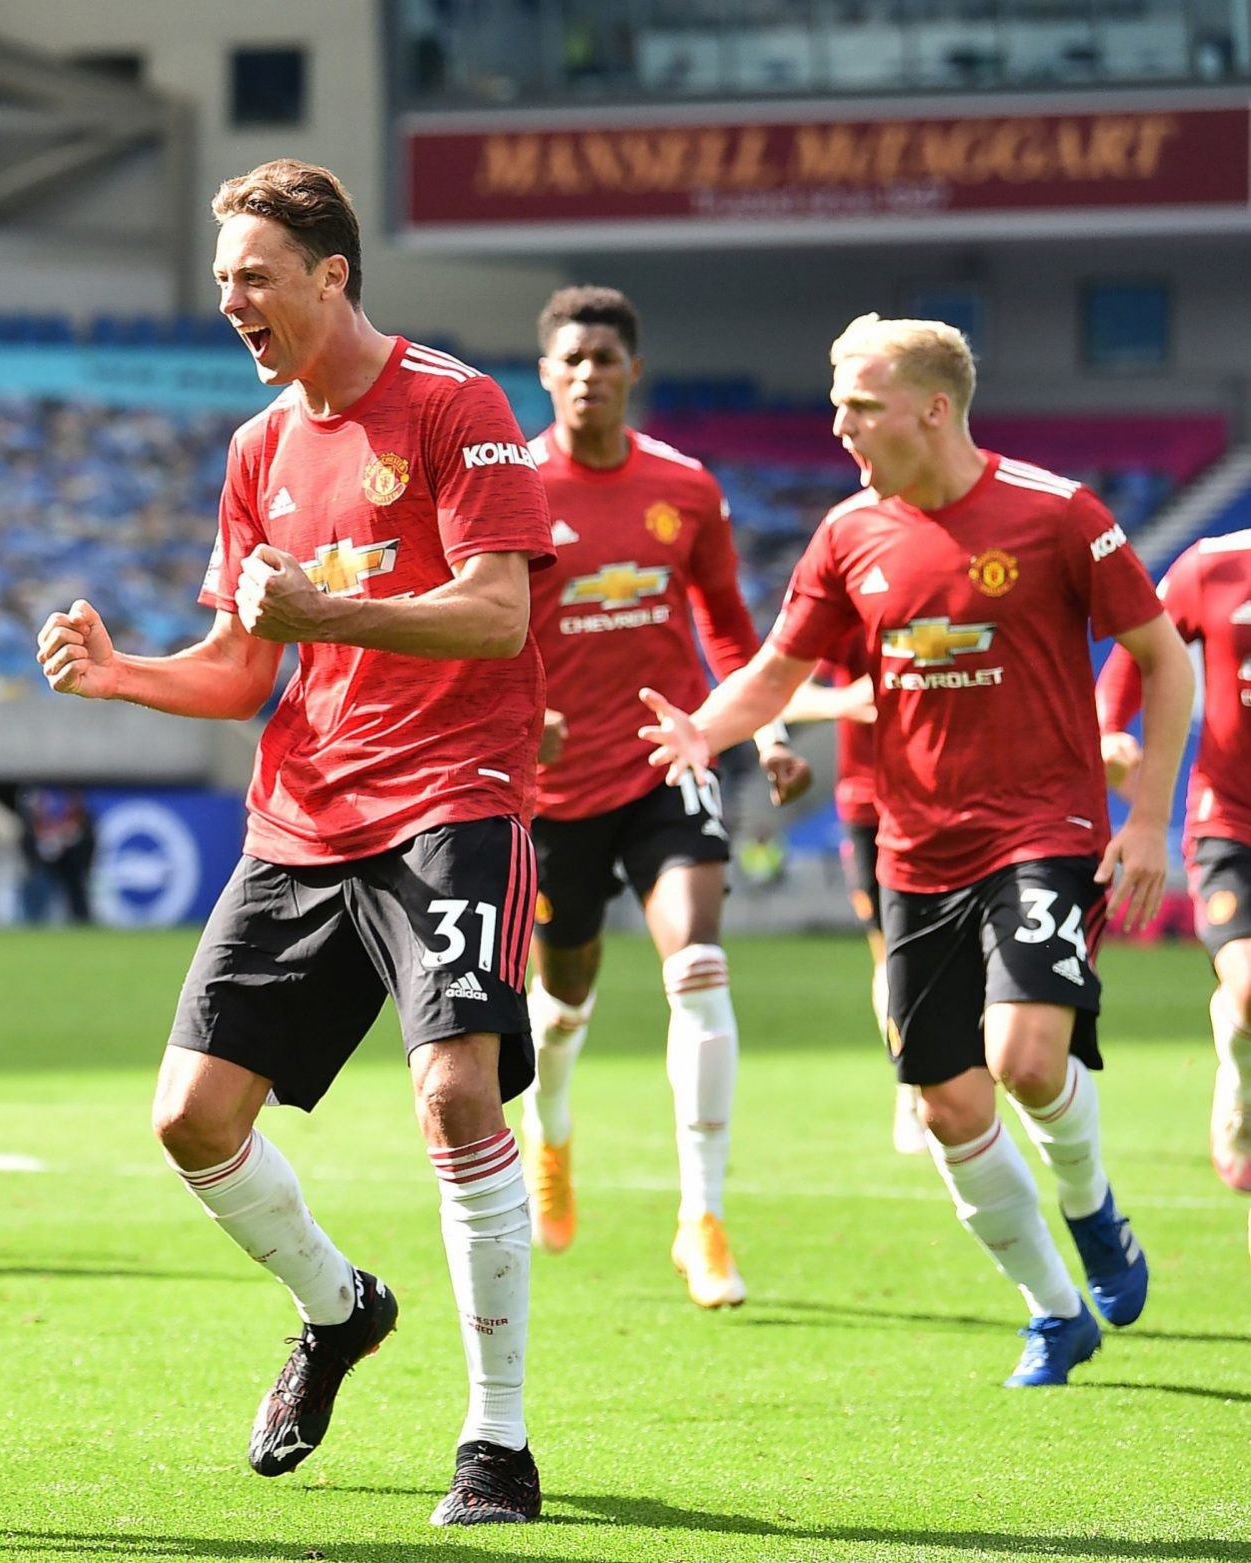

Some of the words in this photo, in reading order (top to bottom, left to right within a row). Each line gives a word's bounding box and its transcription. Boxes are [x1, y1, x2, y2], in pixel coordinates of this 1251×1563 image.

[462, 442, 538, 472] KOHLE
[560, 604, 670, 635] CHEVROLET
[678, 767, 724, 820] 10
[421, 899, 497, 972] 31
[1014, 888, 1088, 962] 34
[445, 987, 488, 1002] adidas
